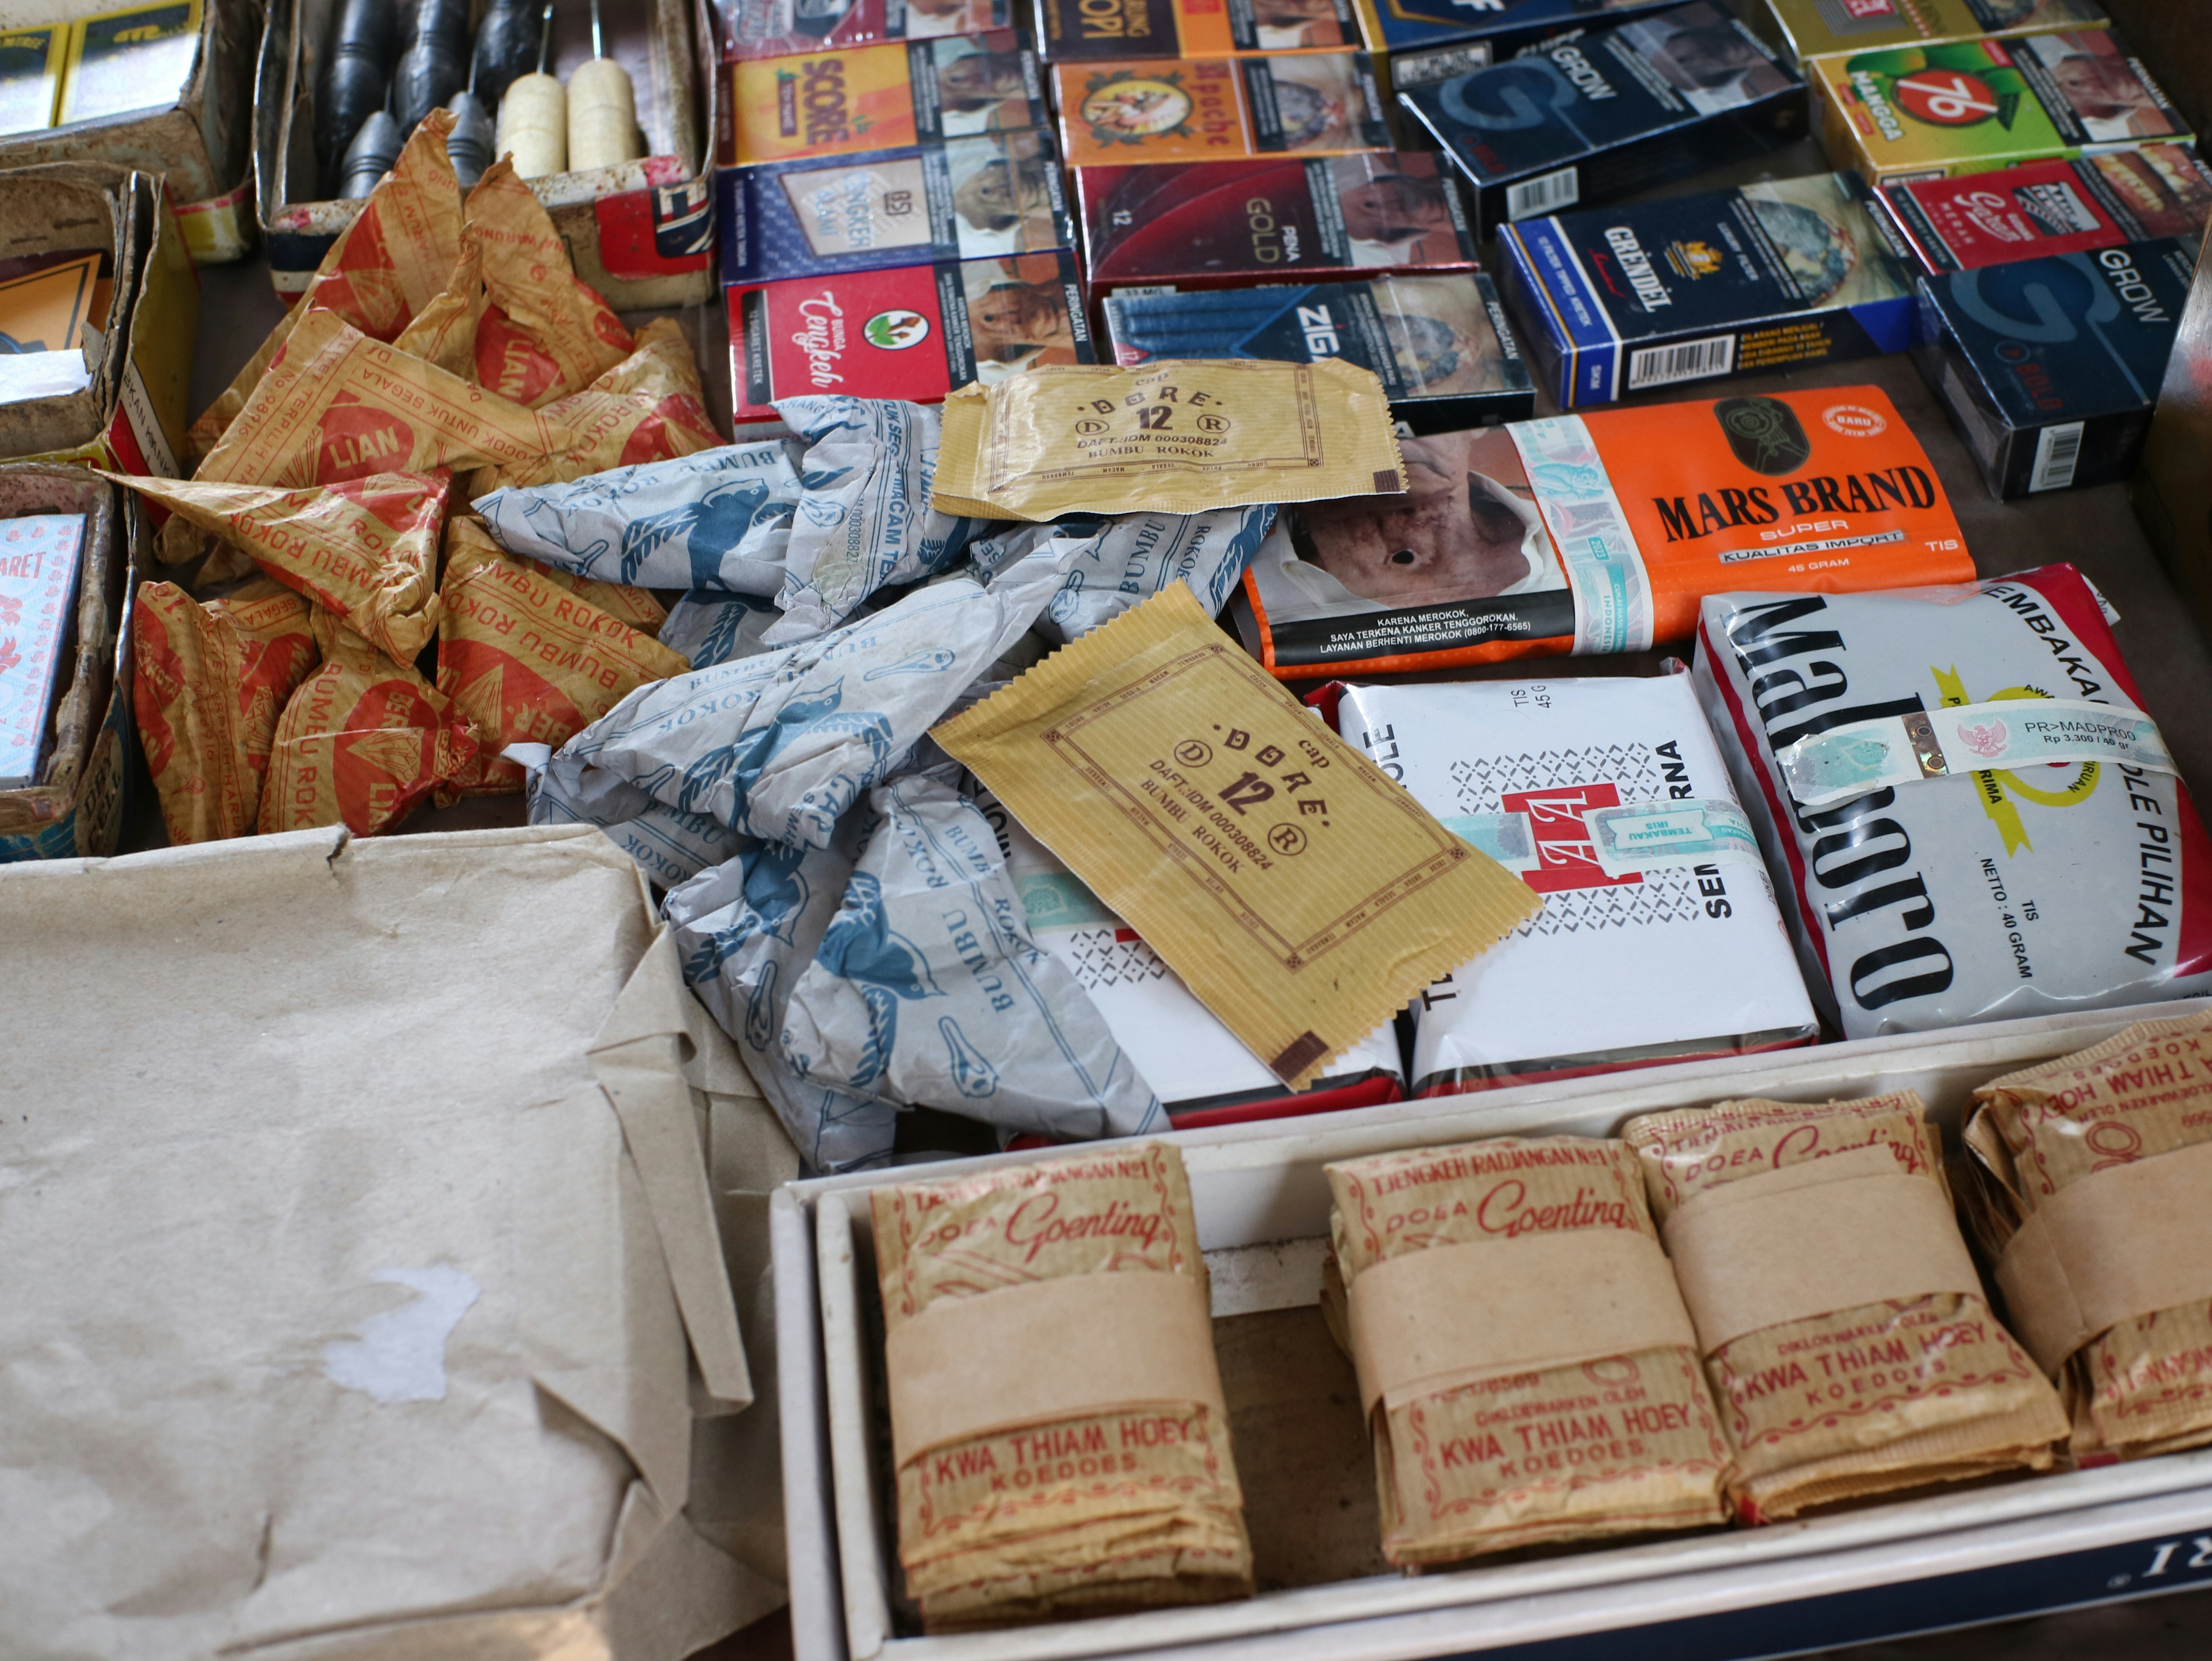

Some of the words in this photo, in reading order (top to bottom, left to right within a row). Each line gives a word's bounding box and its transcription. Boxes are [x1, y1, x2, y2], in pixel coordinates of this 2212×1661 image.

[1551, 45, 1616, 101] GROW
[802, 59, 850, 145] SCORE
[1850, 71, 1905, 143] MANGGA
[1112, 210, 1133, 226] 12
[1246, 197, 1280, 264] GOLD
[1281, 225, 1301, 263] PENA
[2099, 249, 2170, 323] GROW
[832, 317, 847, 352] BUNGA
[1064, 283, 1088, 343] PERINGATAN
[1487, 300, 1520, 360] PERINGATAN
[792, 289, 844, 389] Cengkeh
[362, 368, 426, 409] SEGALA
[497, 338, 533, 399] LIAN
[427, 403, 480, 439] UNTUK
[1091, 386, 1212, 414] DORE
[1136, 405, 1173, 430] 12
[1836, 416, 1872, 428] BARU
[255, 388, 313, 459] TERPILIH
[1155, 435, 1227, 446] 000308824
[328, 425, 401, 470] LIAN
[1089, 446, 1144, 458] BUMBU
[1157, 446, 1215, 458] ROKOK
[1042, 471, 1074, 480] TEMBAKAU
[1652, 486, 1780, 543] MARS
[1779, 465, 1936, 517] BRAND
[228, 512, 308, 560] ROKOK
[1590, 540, 1607, 559] 2023
[1722, 540, 1821, 563] KUALITAS
[1823, 530, 1903, 549] IMPORT
[1759, 519, 1849, 541] SUPER
[1924, 539, 1958, 552] TIS
[0, 551, 47, 579] ARET
[1119, 519, 1167, 595] BUMBU
[1176, 525, 1212, 583] ROKOK
[1788, 563, 1805, 573] 45
[1808, 558, 1850, 570] GRAM
[243, 597, 299, 626] SEGALA
[487, 562, 551, 608] MBU
[553, 598, 644, 650] ROKOK
[1330, 632, 1355, 642] SAYA
[1356, 627, 1401, 639] TERKENA
[1402, 623, 1441, 634] KANKER
[1443, 612, 1519, 629] TENGGOROKAN.
[1377, 617, 1417, 627] KARENA
[1418, 609, 1469, 623] MEROKOK,
[1320, 642, 1363, 653] LAYANAN
[1366, 637, 1412, 649] BERHENTI
[1414, 630, 1462, 643] MEROKOK
[1463, 622, 1531, 639] (0800-177-6565)
[519, 632, 620, 691] BUMBU
[1148, 670, 1169, 685] MACAM
[1511, 690, 1529, 708] TIS
[1535, 695, 1551, 708] 45
[1298, 740, 1330, 769] cap
[2043, 735, 2061, 744] Rp
[2064, 734, 2093, 743] 3.300
[2103, 737, 2116, 746] 40
[2118, 742, 2129, 750] gr
[1218, 771, 1275, 816] 12
[1223, 728, 1328, 816] DORE
[1357, 766, 1378, 783] MACAM
[293, 766, 318, 827] ROK
[368, 782, 397, 831] LIA
[1720, 595, 1955, 1012] Maloro
[1140, 779, 1191, 823] BUMBU
[1192, 825, 1245, 875] ROKOK
[1209, 812, 1274, 870] 000308824
[1629, 828, 1693, 841] TEMBAKAU
[1980, 857, 2007, 902] NETTO
[2124, 821, 2175, 967] PILIHAN
[2002, 913, 2018, 930] 40
[2021, 899, 2040, 922] TIS
[946, 908, 1015, 1013] BUMBU
[2008, 931, 2033, 979] GRAM
[2110, 1057, 2196, 1098] THIAM
[2036, 1085, 2098, 1125] HOEY
[1370, 1154, 1470, 1197] TJENGKEH
[1471, 1149, 1578, 1178] RADJANGAN
[1684, 1147, 1764, 1182] DOEA
[1006, 1192, 1160, 1264] Goenting
[1385, 1200, 1469, 1233] DOEA
[1477, 1179, 1626, 1238] Goenting
[1742, 1362, 1807, 1402] KWA
[1814, 1335, 1910, 1379] THIAM
[1918, 1321, 1987, 1359] HOEY
[934, 1448, 996, 1485] KWA
[1010, 1425, 1109, 1466] THIAM
[1119, 1416, 1192, 1450] HOEY
[1438, 1437, 1503, 1470] KWA
[1514, 1417, 1613, 1452] THIAM
[1624, 1404, 1693, 1434] HOEY
